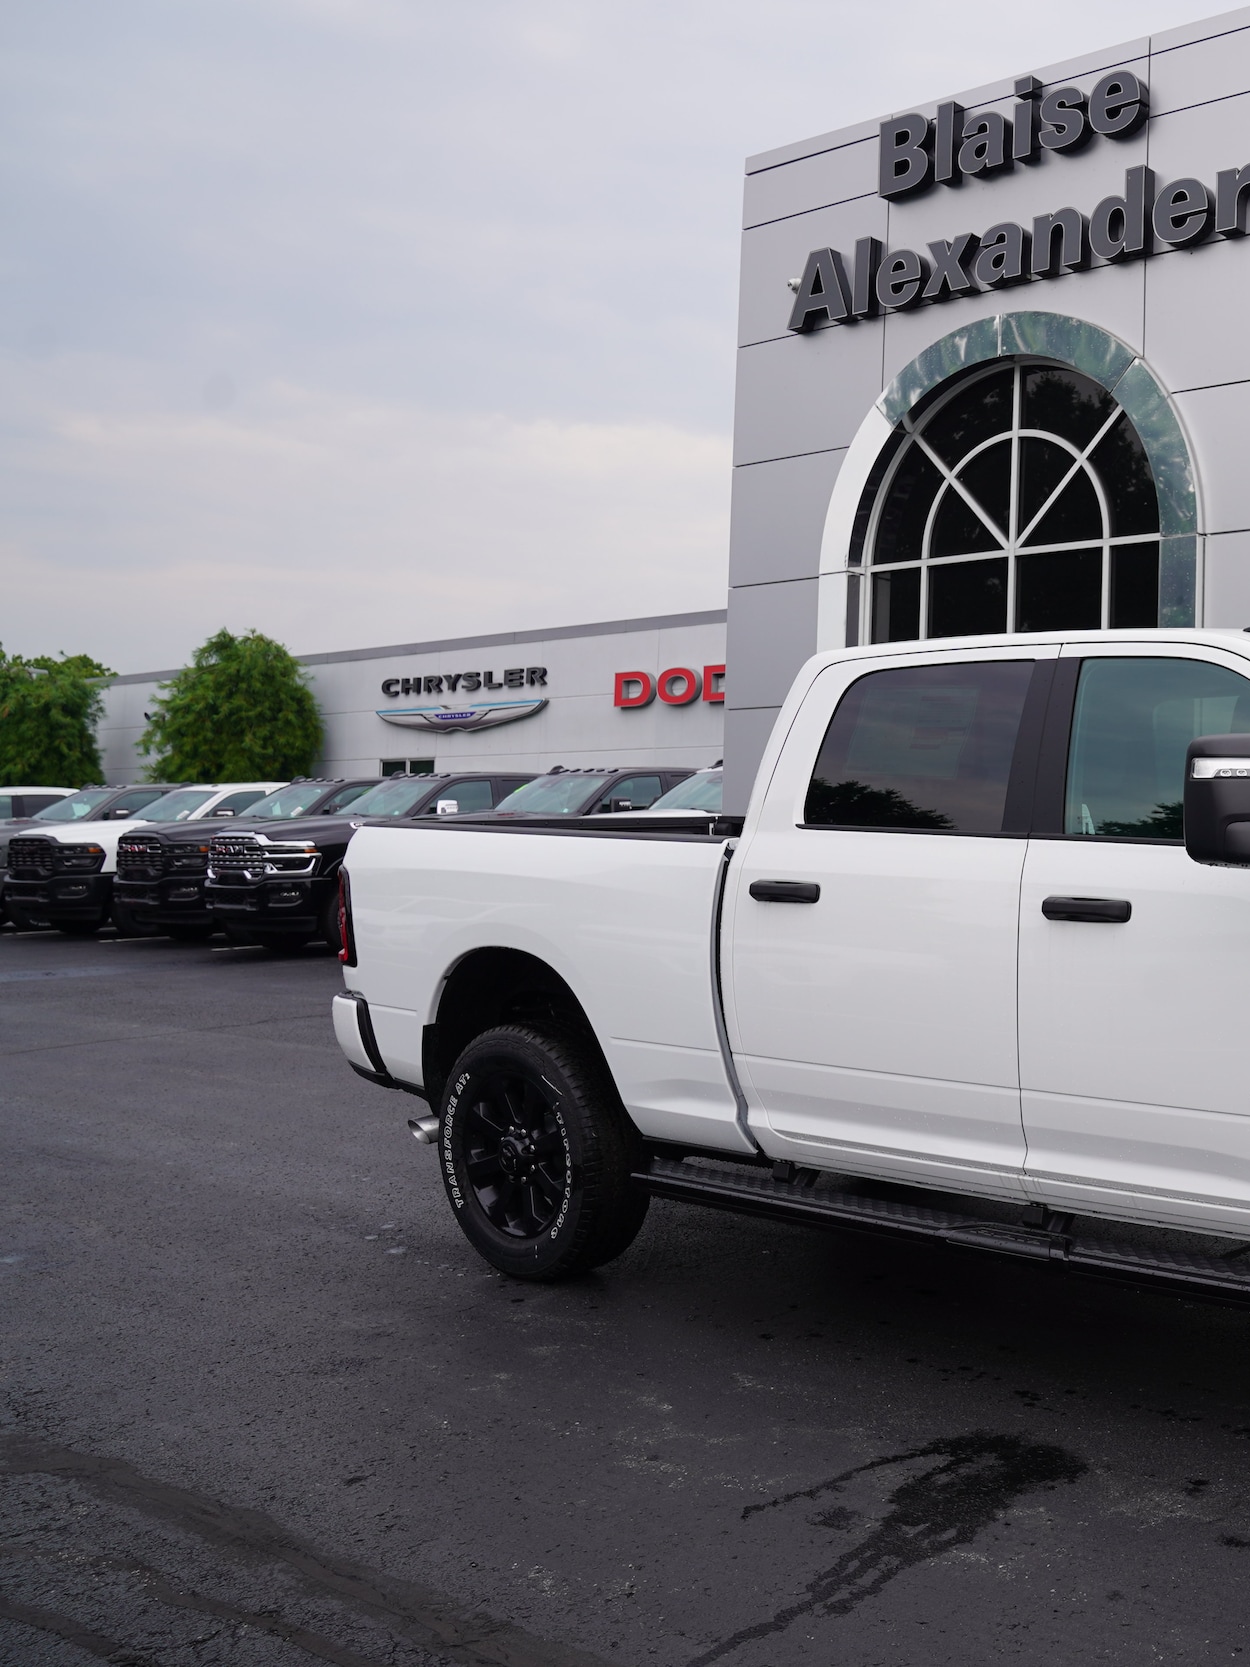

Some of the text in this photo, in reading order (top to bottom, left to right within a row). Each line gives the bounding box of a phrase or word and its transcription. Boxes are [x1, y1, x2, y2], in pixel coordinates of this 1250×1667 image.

[877, 69, 1151, 201] Blaise
[381, 666, 549, 698] CHRYSLER
[443, 1095, 465, 1209] TRANSFORCE
